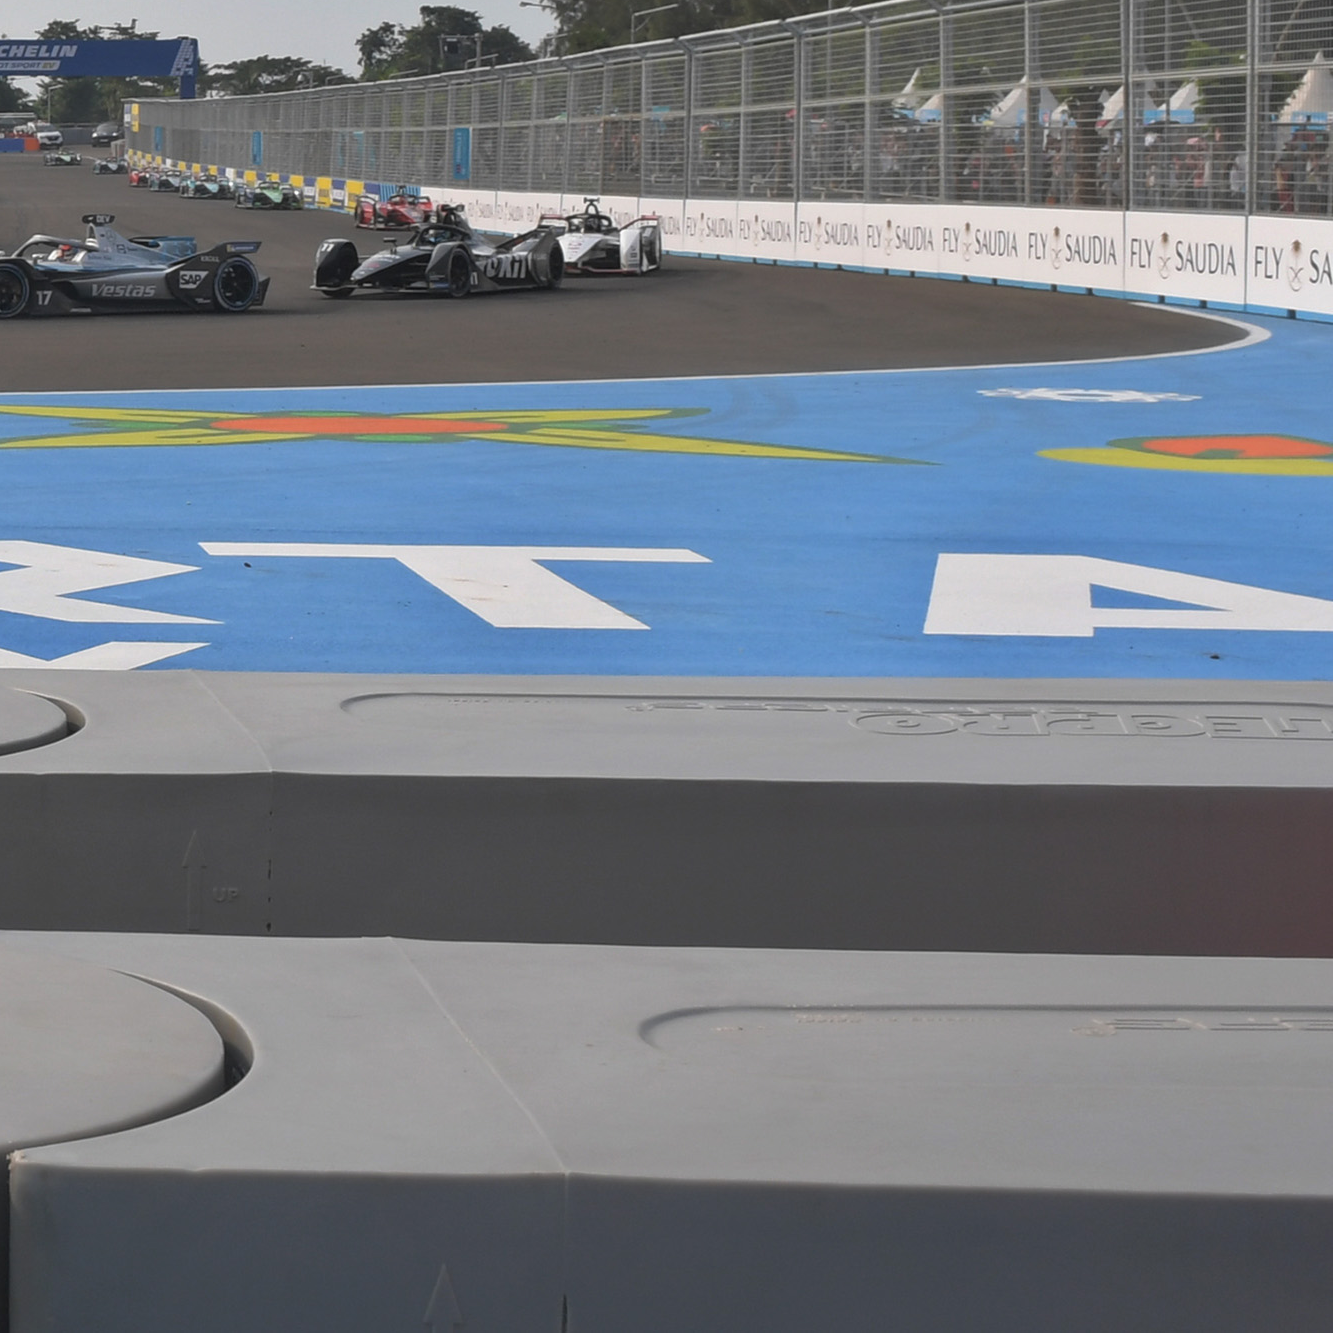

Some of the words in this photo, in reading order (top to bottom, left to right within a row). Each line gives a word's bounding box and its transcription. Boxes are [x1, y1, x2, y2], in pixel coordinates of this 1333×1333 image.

[740, 219, 750, 240] FLY
[761, 220, 791, 242] SAUDIA
[799, 221, 812, 244] FLY
[824, 222, 859, 246] SAUDIA
[866, 224, 882, 248] FLY
[895, 226, 934, 251] SAUDIA
[942, 227, 960, 253] FLY
[974, 229, 1018, 258] SAUDIA
[1028, 232, 1048, 260] FLY
[1065, 234, 1117, 265] SAUDIA
[1130, 238, 1154, 269] FLY
[1175, 240, 1237, 276] SAUDIA
[1254, 246, 1284, 279] FLY
[91, 283, 157, 298] Vestas
[181, 274, 202, 285] SAP
[36, 290, 53, 306] 17
